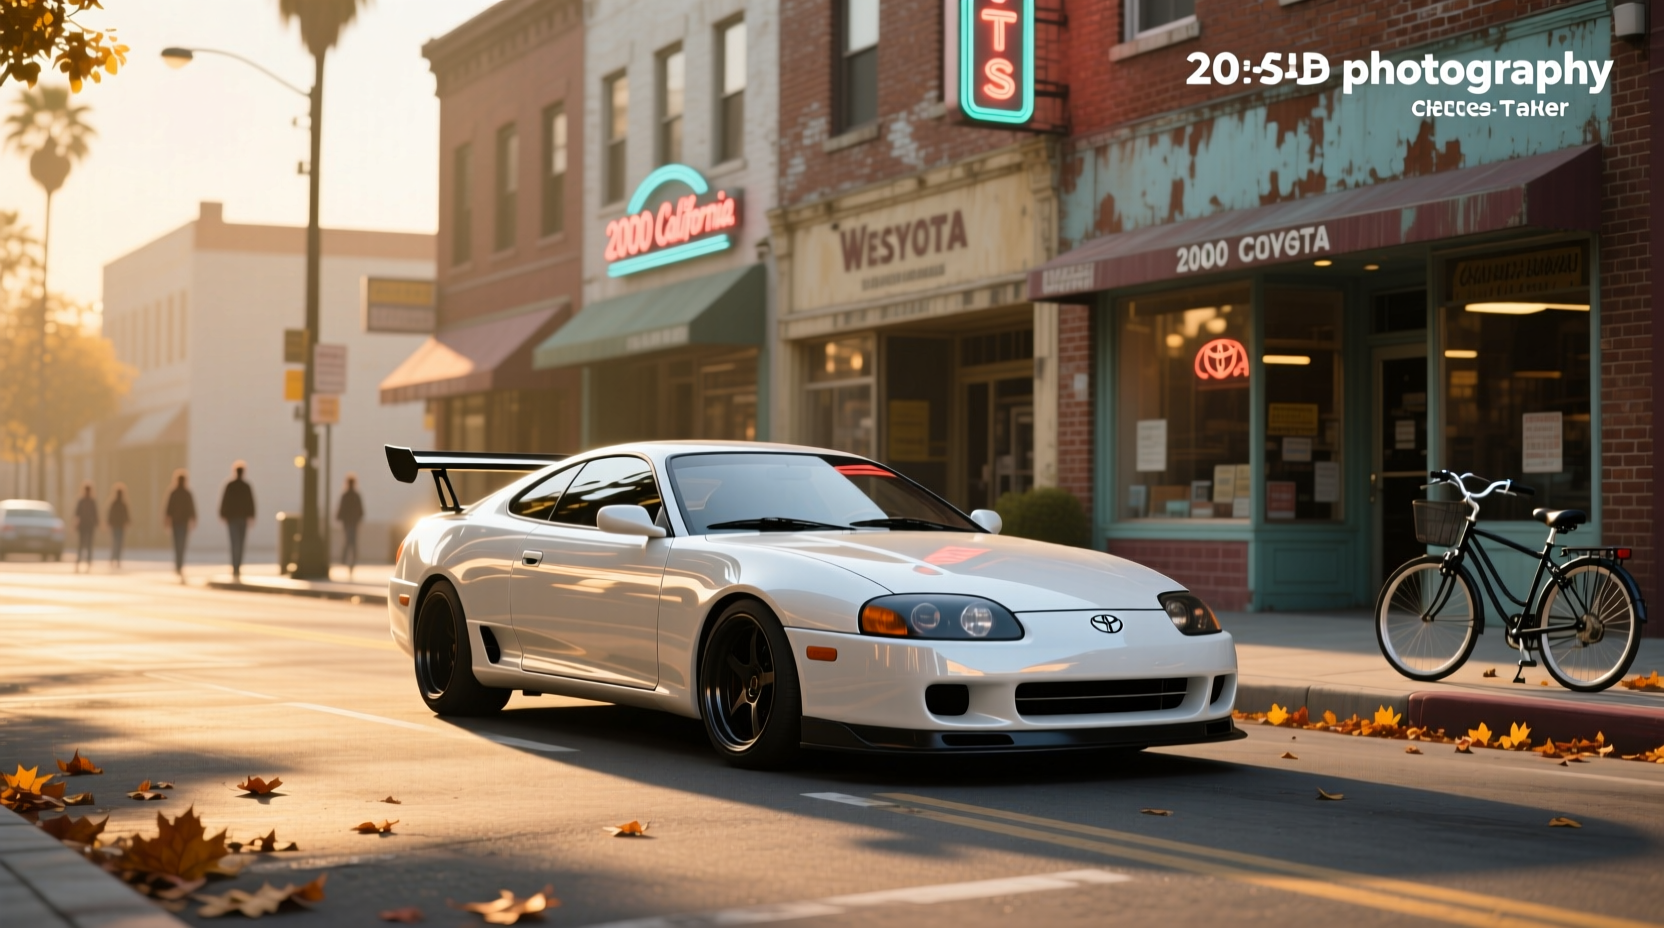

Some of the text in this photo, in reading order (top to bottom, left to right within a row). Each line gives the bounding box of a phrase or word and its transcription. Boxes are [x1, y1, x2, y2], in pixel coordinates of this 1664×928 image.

[980, 0, 1018, 100] TS
[605, 189, 736, 261] 2000 California
[1176, 239, 1229, 273] 2000
